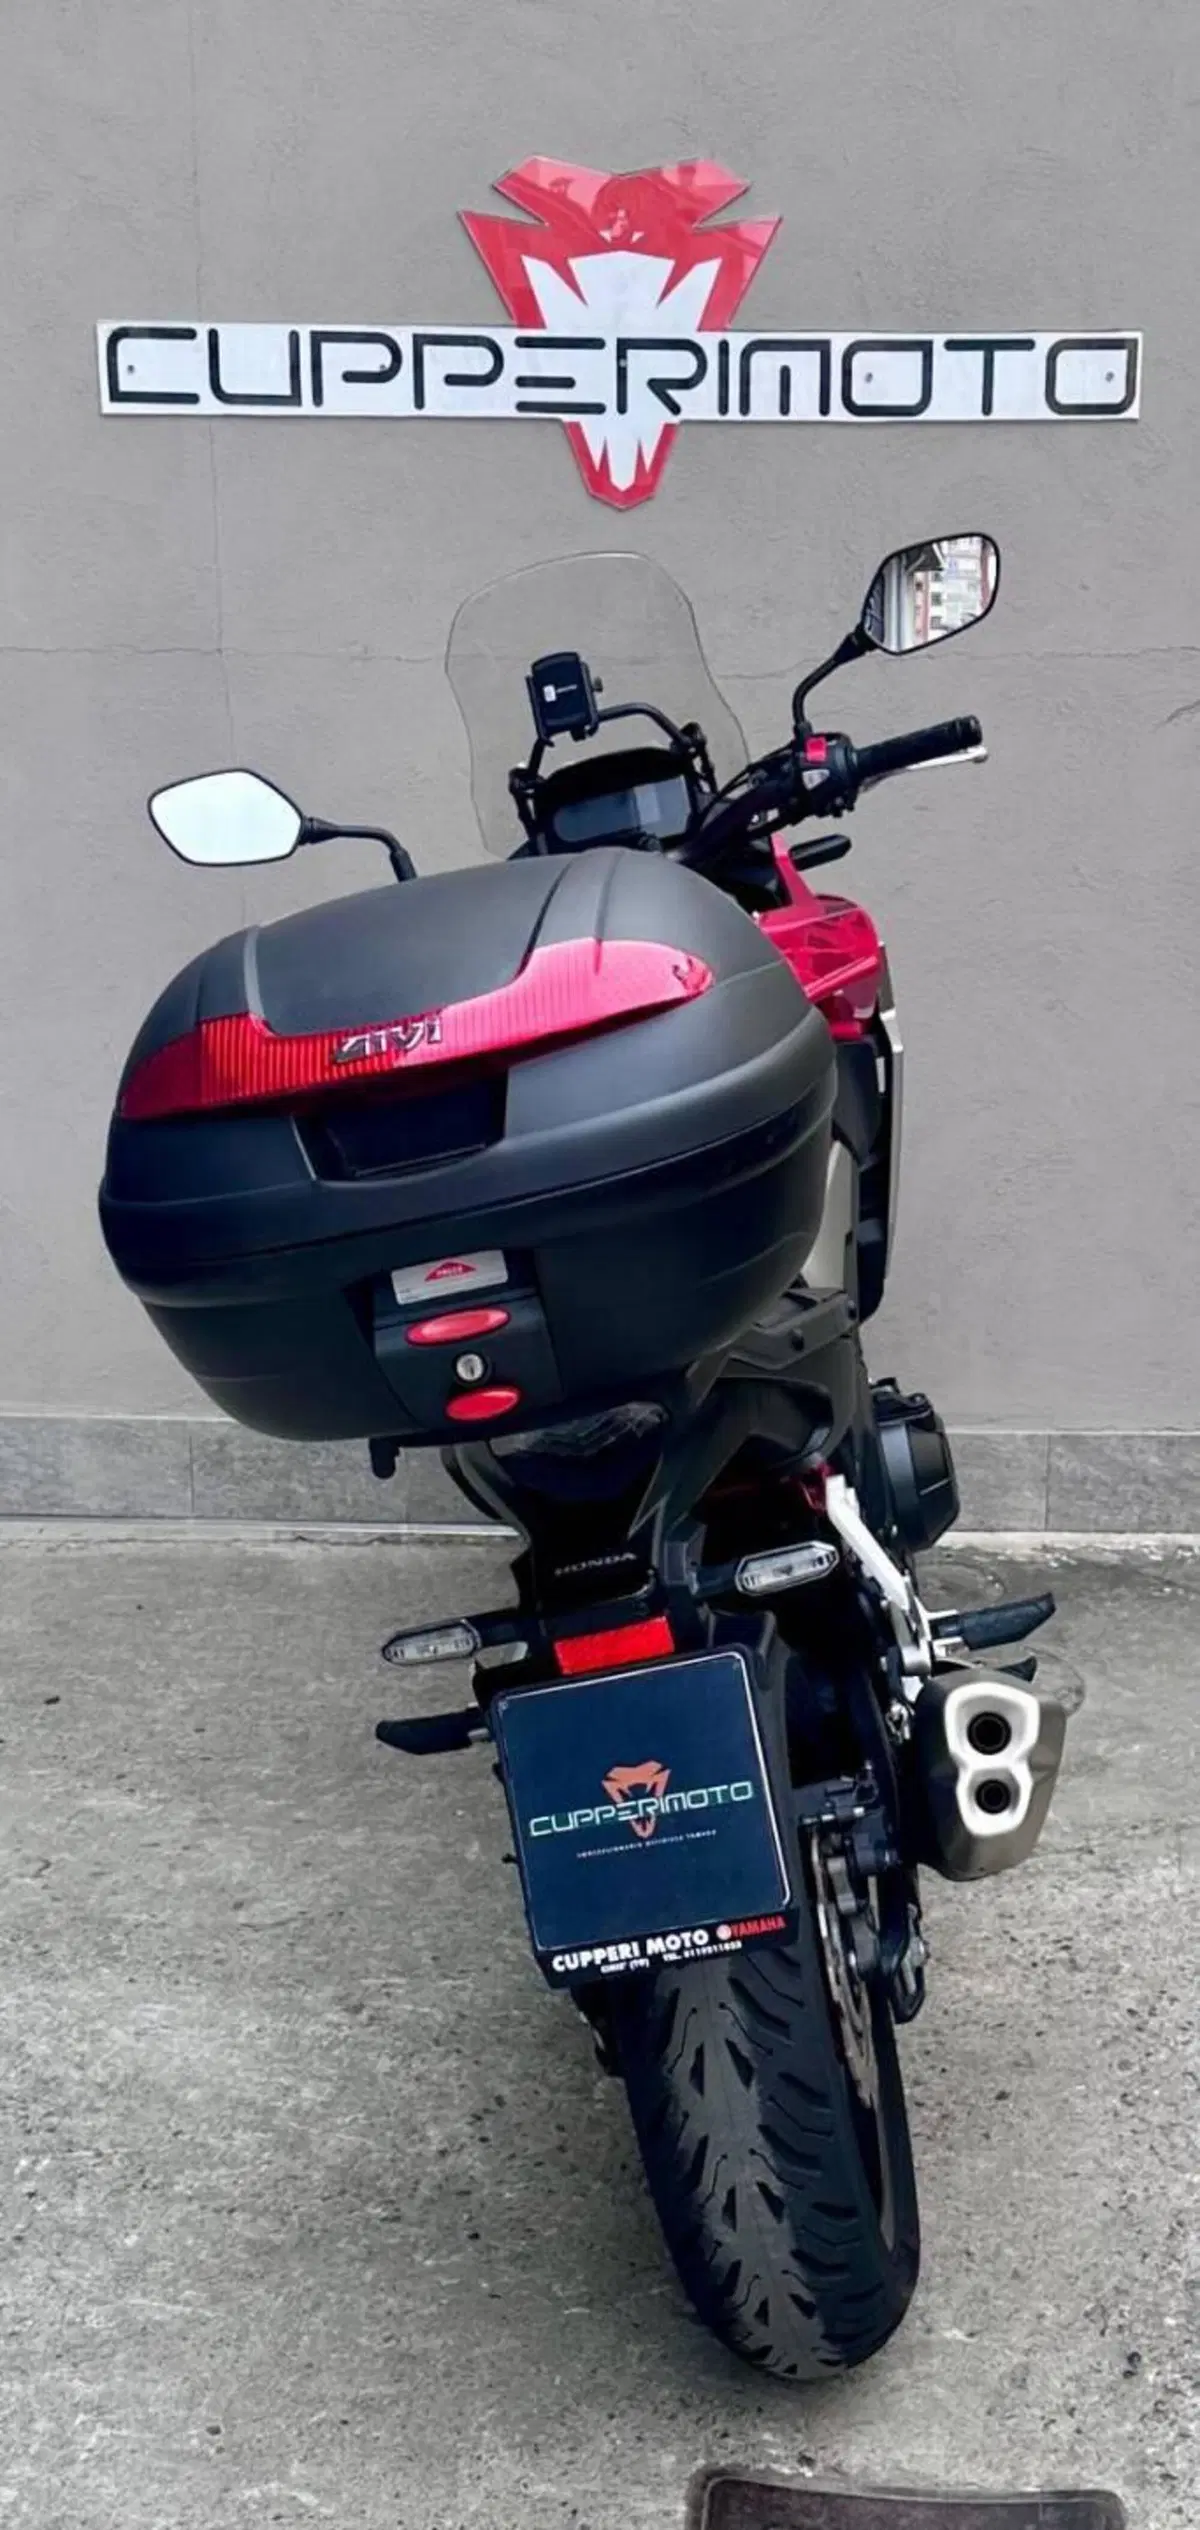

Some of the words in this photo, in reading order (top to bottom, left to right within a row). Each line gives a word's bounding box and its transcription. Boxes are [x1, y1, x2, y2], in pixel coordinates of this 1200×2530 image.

[106, 327, 1138, 417] CUPPERIMOTO
[554, 1552, 637, 1576] HONDA
[529, 1780, 754, 1837] CUPPERIMOTO
[552, 1941, 641, 1972] CUPPERI
[646, 1928, 709, 1956] MOTO
[731, 1915, 787, 1937] YAMAHA
